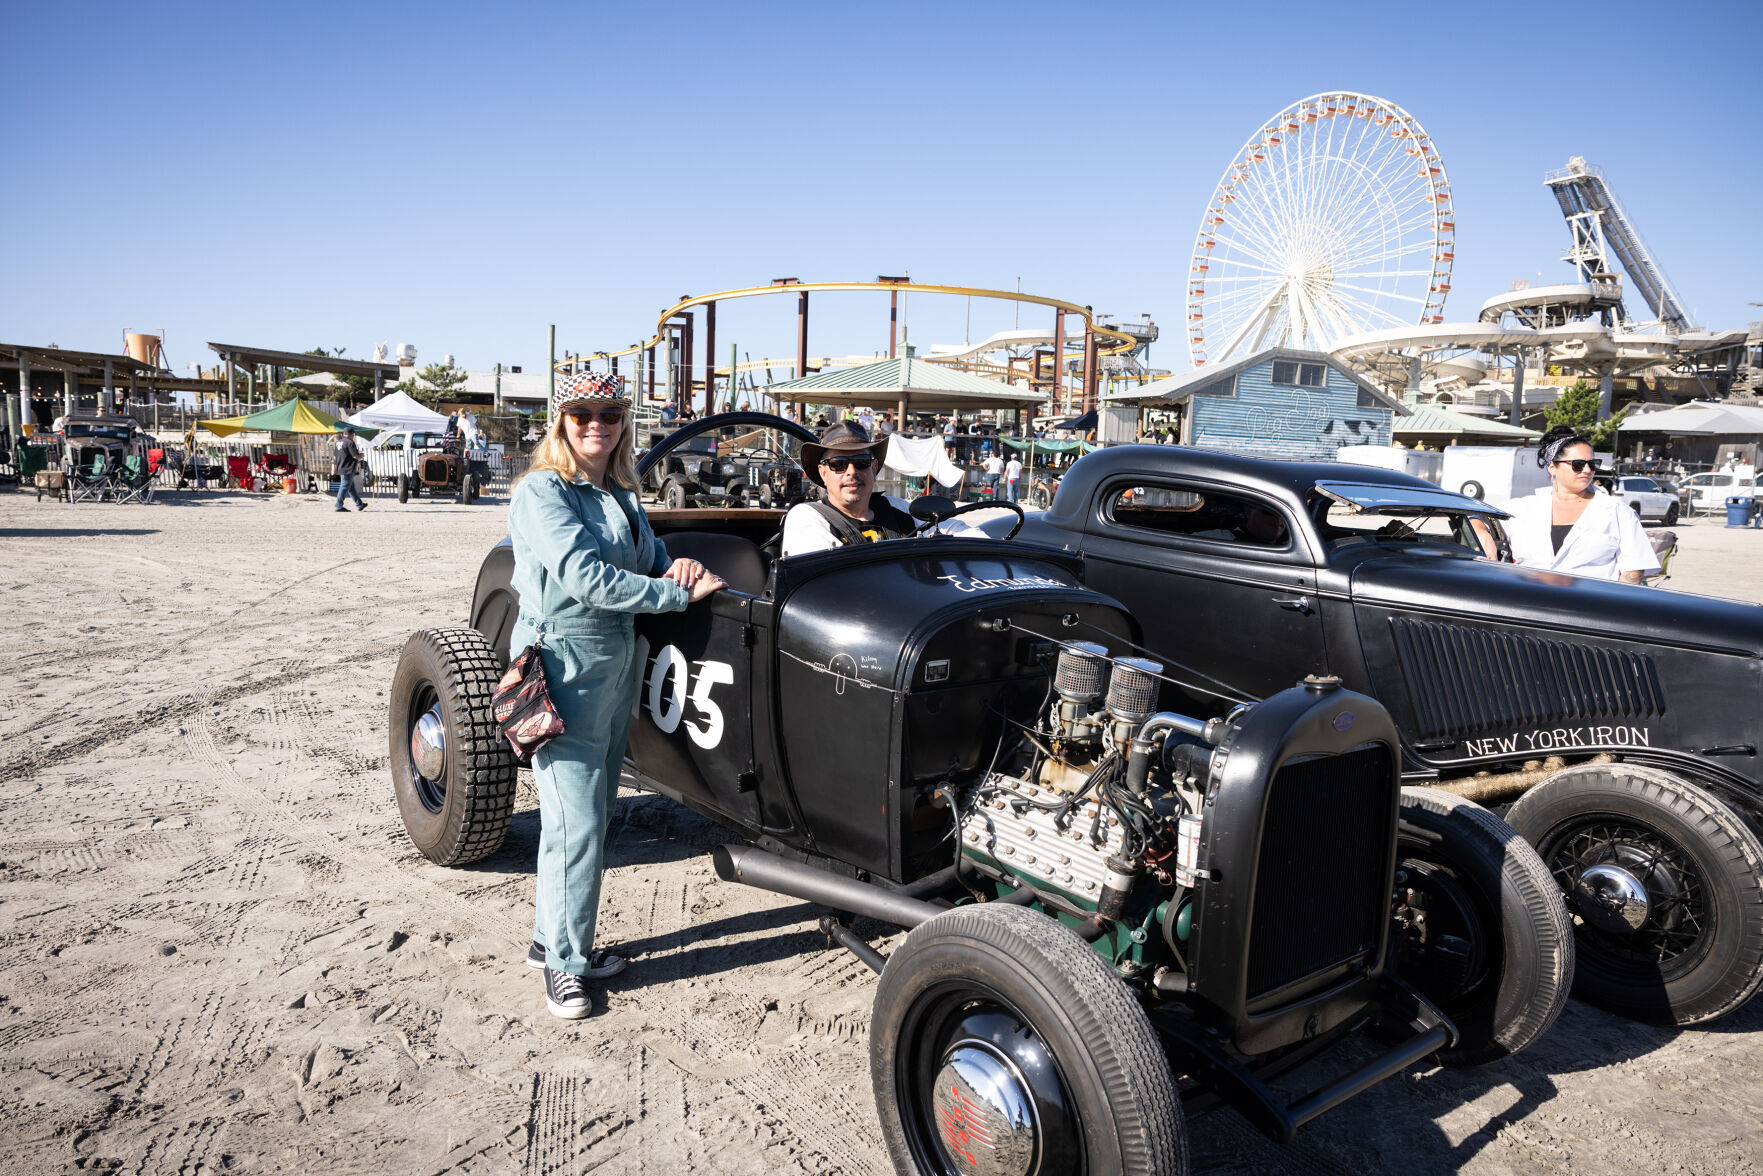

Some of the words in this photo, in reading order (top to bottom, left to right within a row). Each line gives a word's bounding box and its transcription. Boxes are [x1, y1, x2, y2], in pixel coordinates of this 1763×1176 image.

[1246, 406, 1283, 445] Pig
[1286, 389, 1330, 432] Dog
[1466, 733, 1519, 757] NEW
[1524, 727, 1586, 749] YORK
[1590, 726, 1649, 747] IRON
[951, 1085, 977, 1167] FORD
